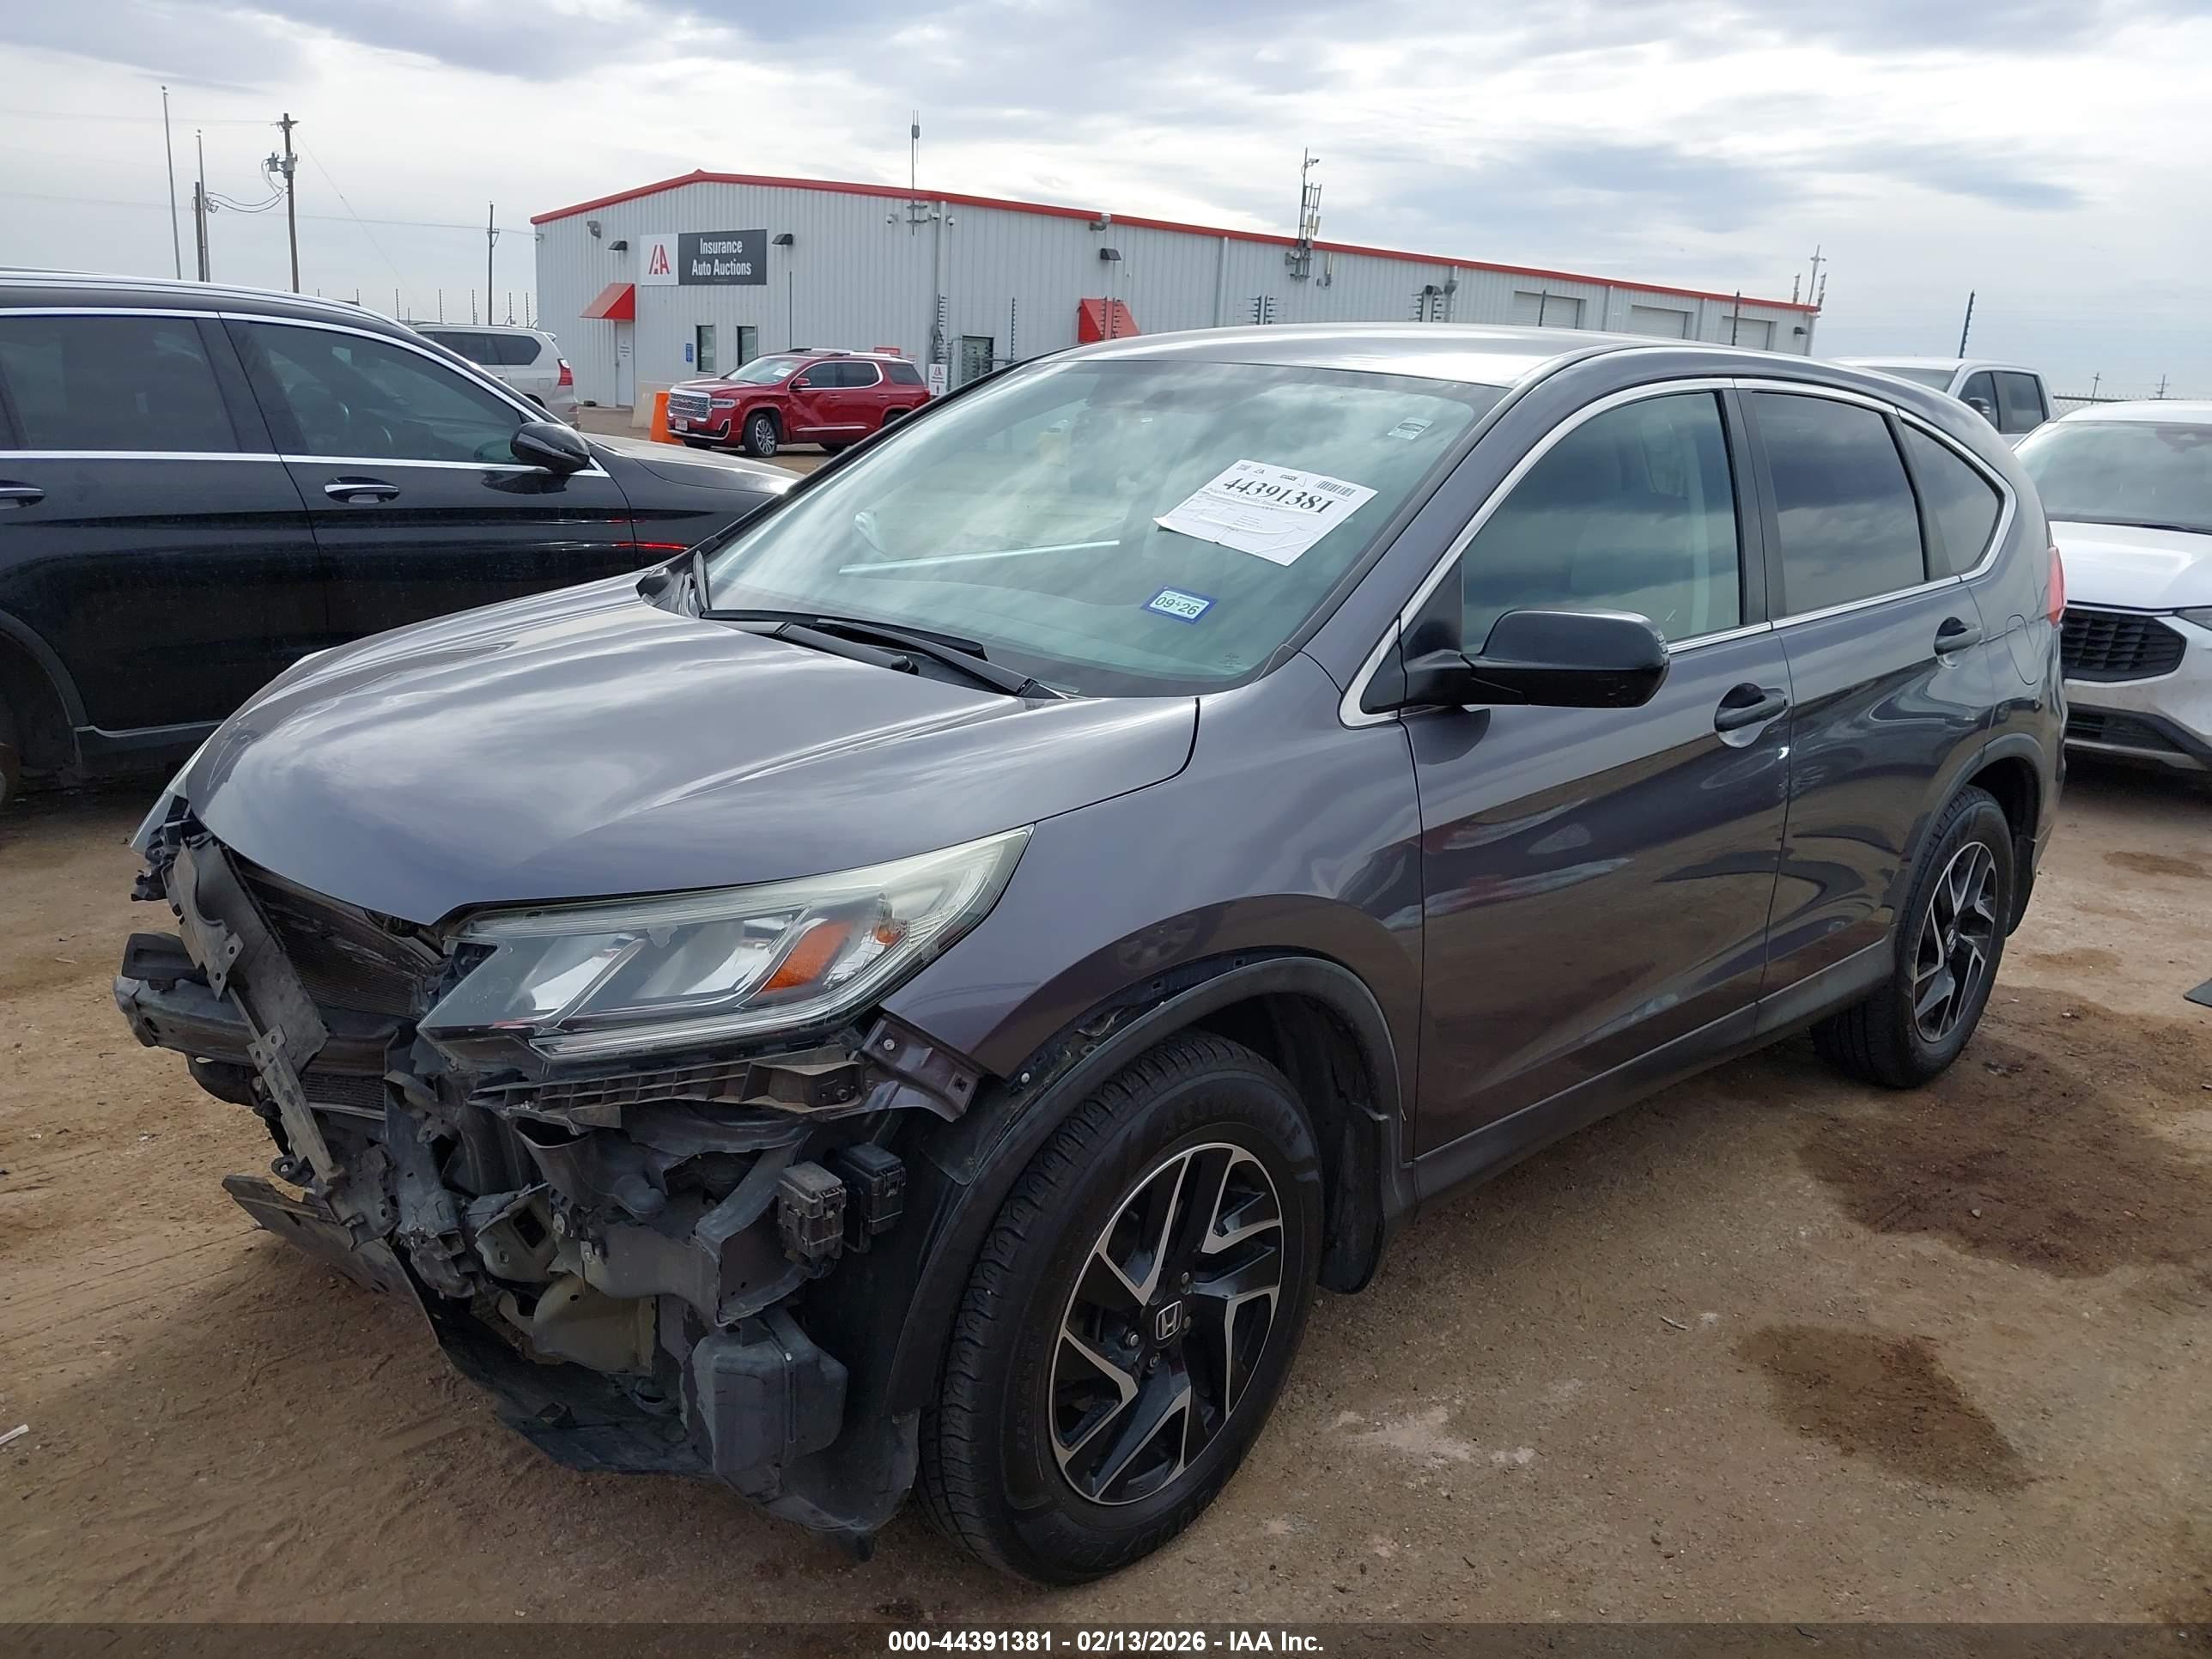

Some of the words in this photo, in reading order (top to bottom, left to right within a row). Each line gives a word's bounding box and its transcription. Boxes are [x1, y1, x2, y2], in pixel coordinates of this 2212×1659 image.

[700, 237, 743, 255] Insurance
[691, 259, 712, 276] Auto
[713, 258, 752, 276] Auctions
[1223, 477, 1334, 514] 44391381
[1155, 596, 1176, 608] 09
[1177, 603, 1200, 615] 26
